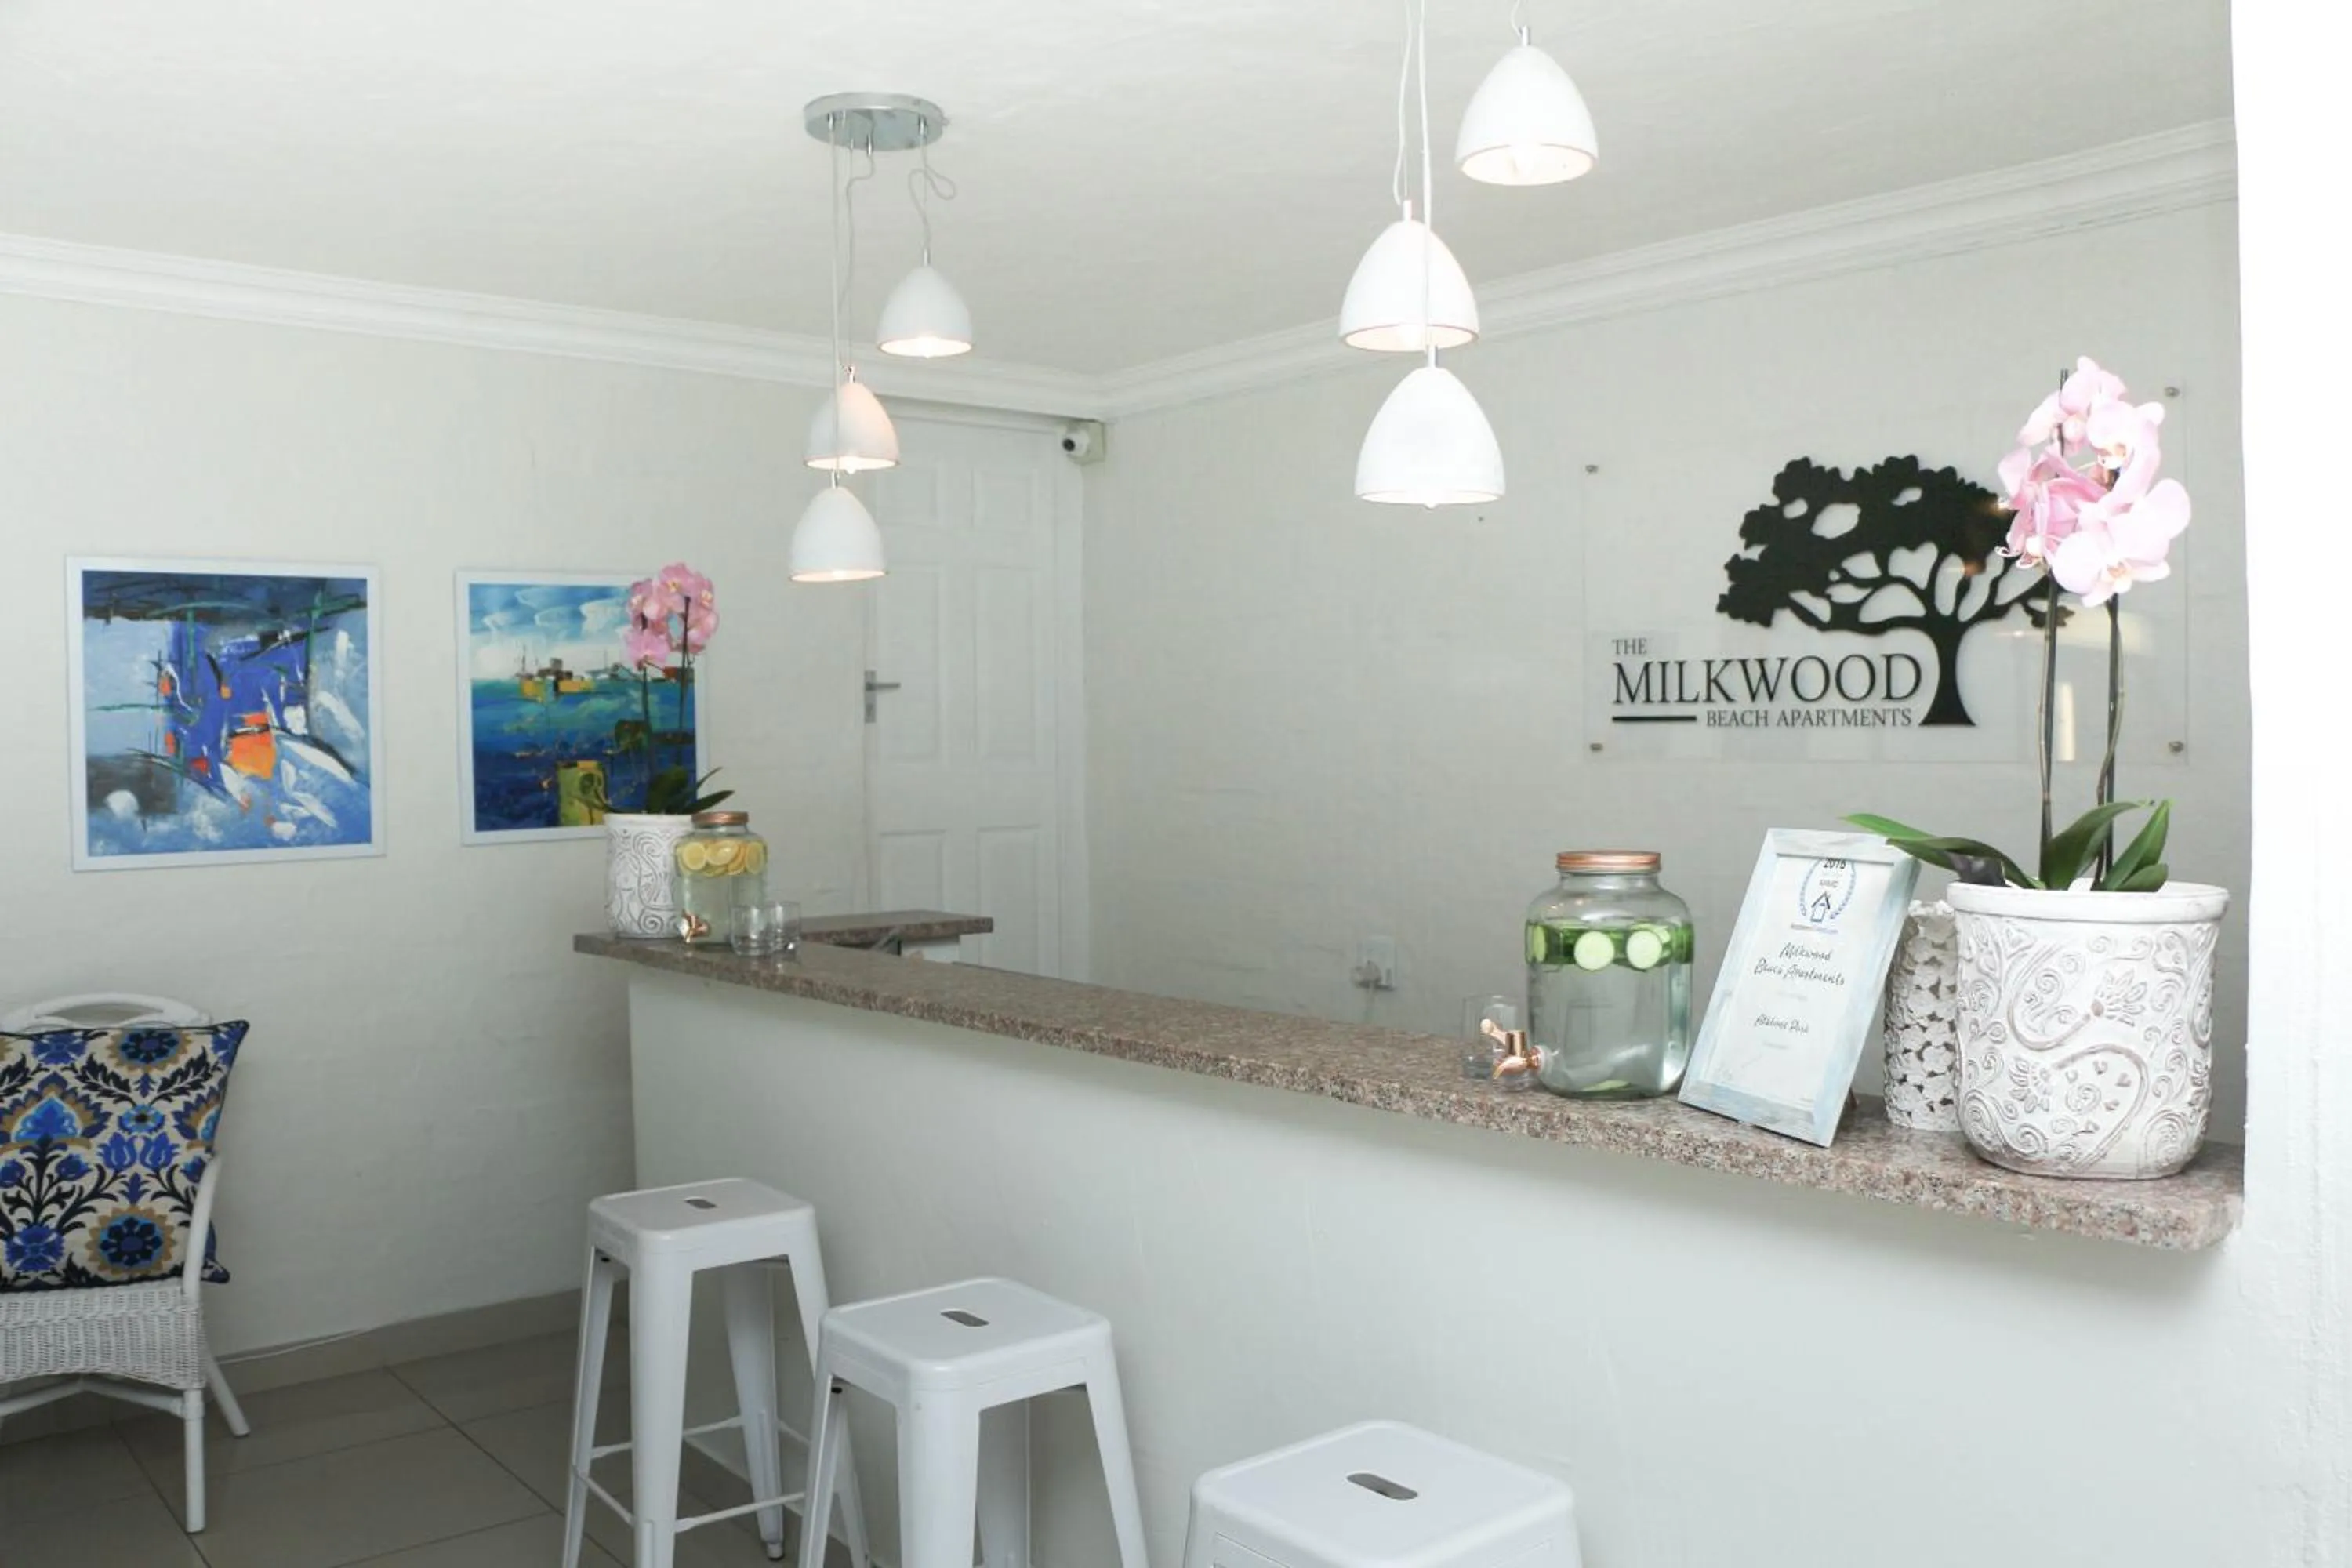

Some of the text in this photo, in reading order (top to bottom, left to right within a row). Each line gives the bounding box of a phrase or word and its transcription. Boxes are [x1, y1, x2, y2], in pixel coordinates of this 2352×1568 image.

[1612, 638, 1646, 655] THE
[1612, 654, 1922, 704] MILKWOOD
[1706, 709, 1912, 728] BEACH APARTMENTS
